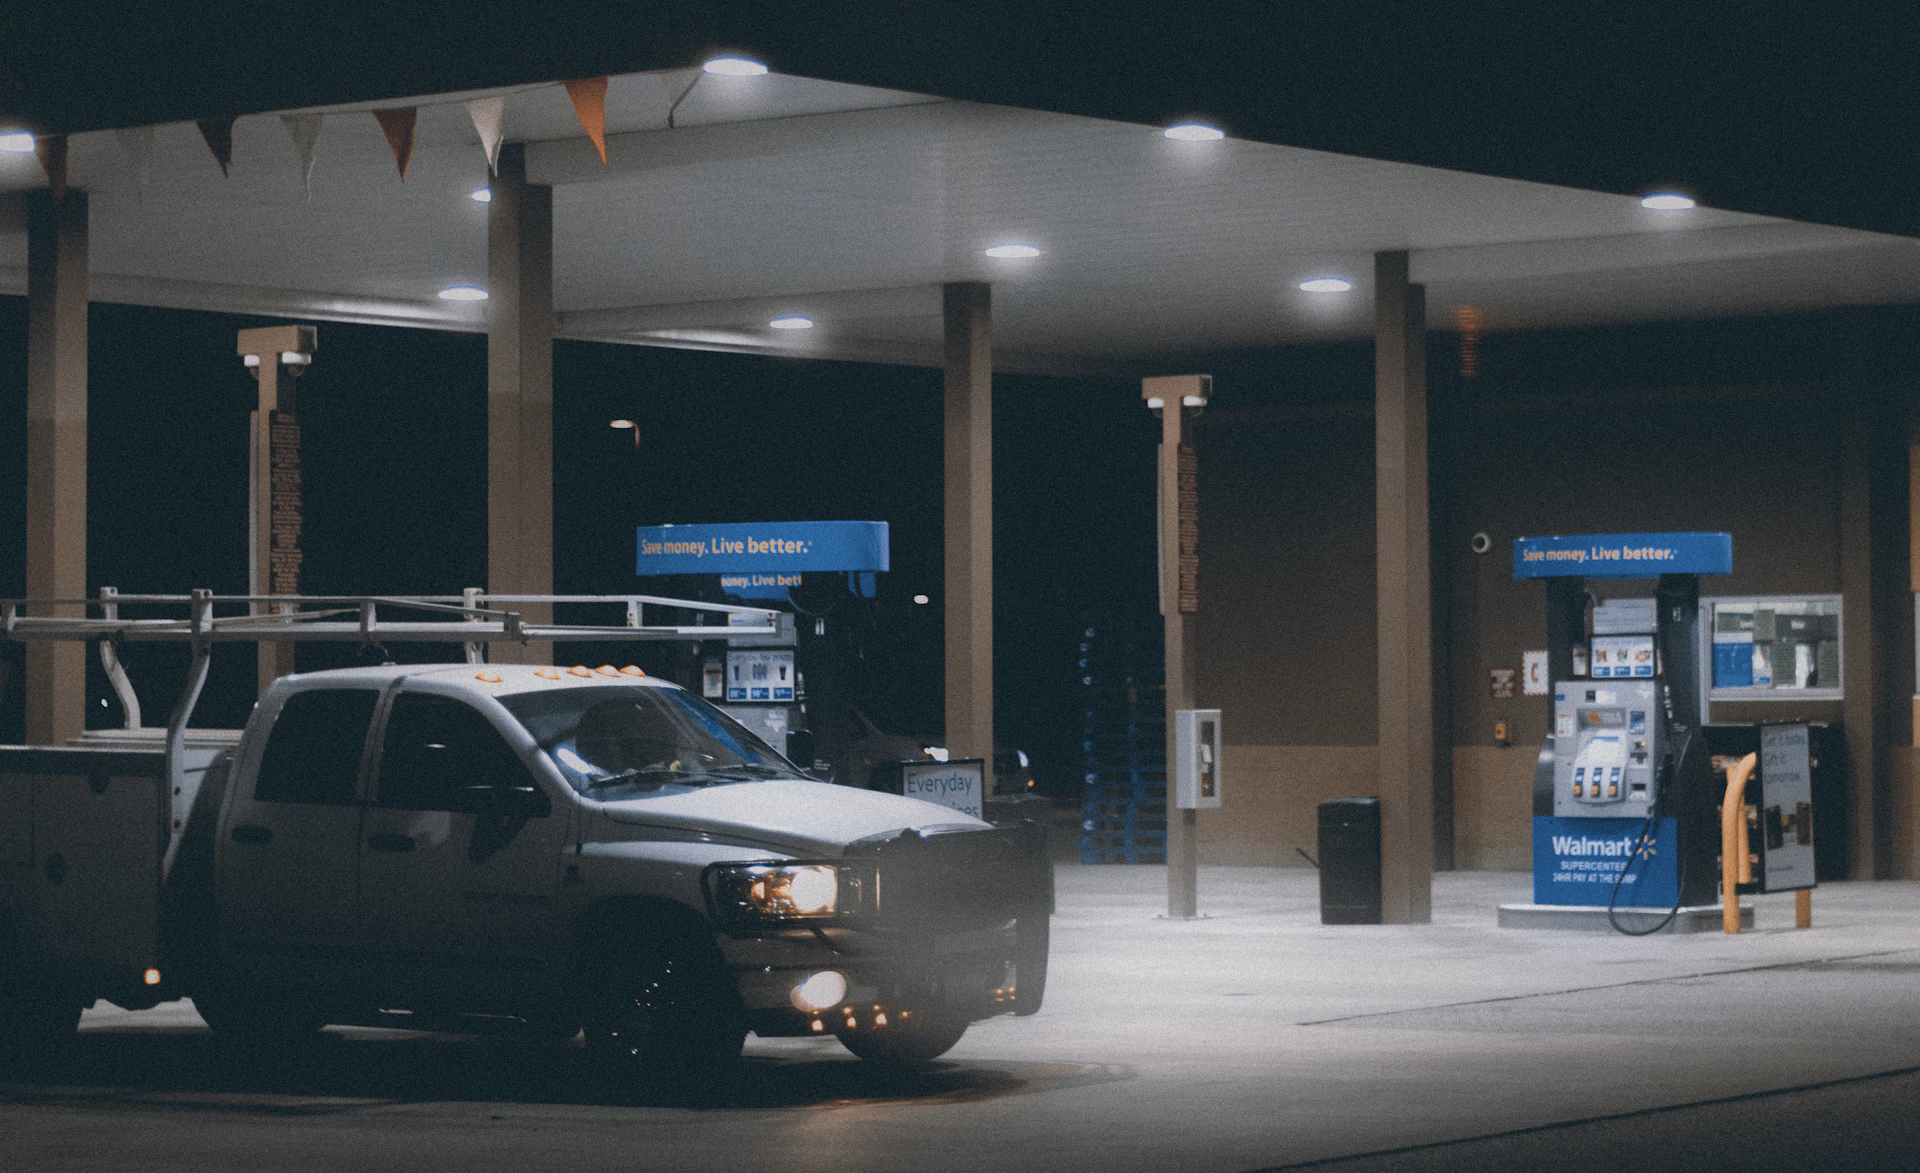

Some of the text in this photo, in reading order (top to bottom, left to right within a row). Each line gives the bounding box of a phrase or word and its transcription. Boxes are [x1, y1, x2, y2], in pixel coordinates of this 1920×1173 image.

[641, 536, 809, 558] Save money. Live better.
[1523, 545, 1674, 563] Save money. Live better.
[752, 574, 775, 586] Live
[907, 771, 972, 797] Everyday
[1552, 836, 1633, 856] Walmart
[1552, 872, 1571, 882] 24HR
[1572, 873, 1587, 883] PAY
[1588, 873, 1597, 883] AT
[1598, 873, 1614, 884] THE
